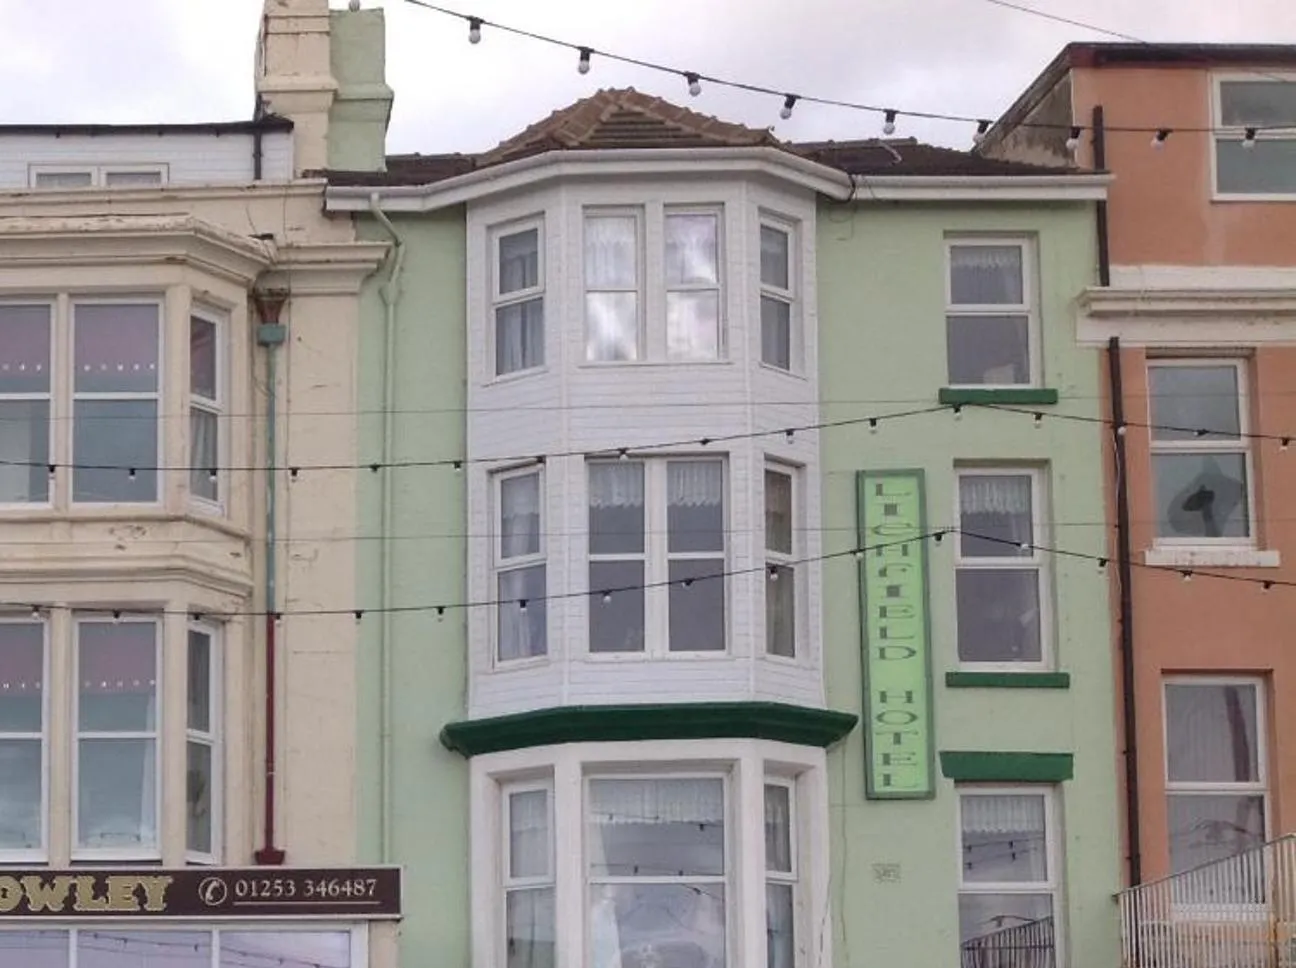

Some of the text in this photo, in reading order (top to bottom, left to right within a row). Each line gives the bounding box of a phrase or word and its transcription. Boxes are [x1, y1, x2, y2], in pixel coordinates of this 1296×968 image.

[871, 483, 919, 788] LICHFIELD HOTEL
[234, 879, 378, 898] 01253 346487
